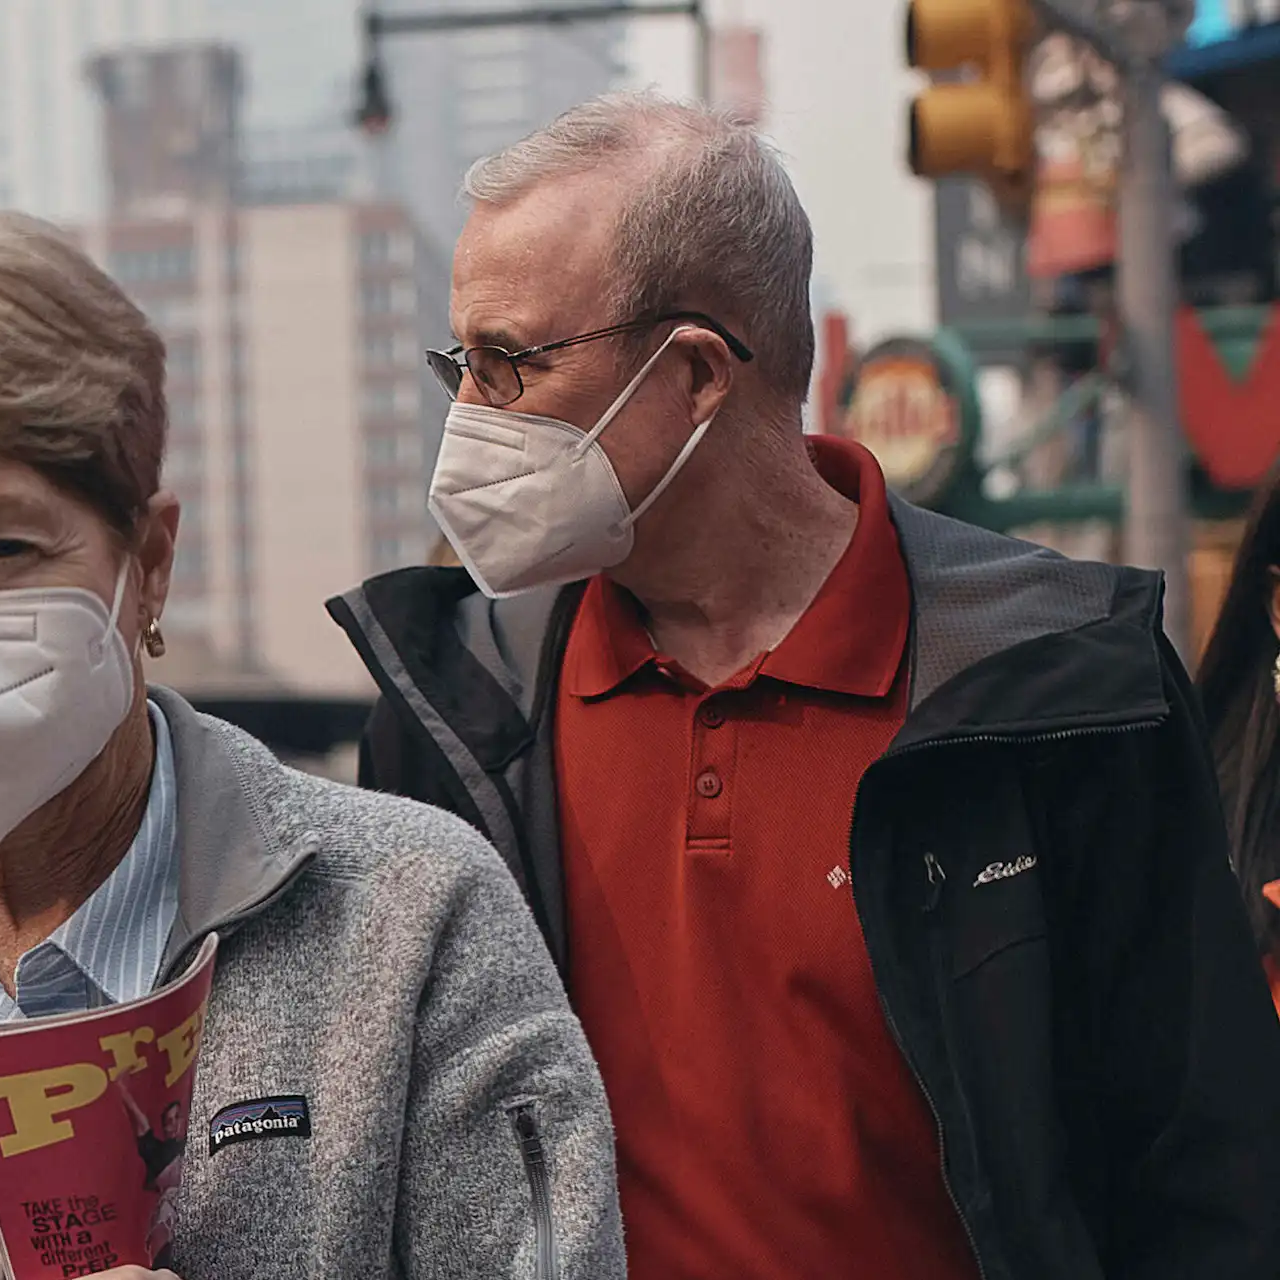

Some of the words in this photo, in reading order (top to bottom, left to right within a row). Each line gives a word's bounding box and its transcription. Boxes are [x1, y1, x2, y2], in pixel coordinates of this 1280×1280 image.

[214, 1116, 298, 1144] patagonia
[21, 1198, 62, 1218] TAKE
[67, 1195, 99, 1211] the
[32, 1203, 118, 1233] STAGE
[31, 1232, 72, 1250] WITH
[77, 1231, 92, 1244] a
[41, 1241, 112, 1266] different
